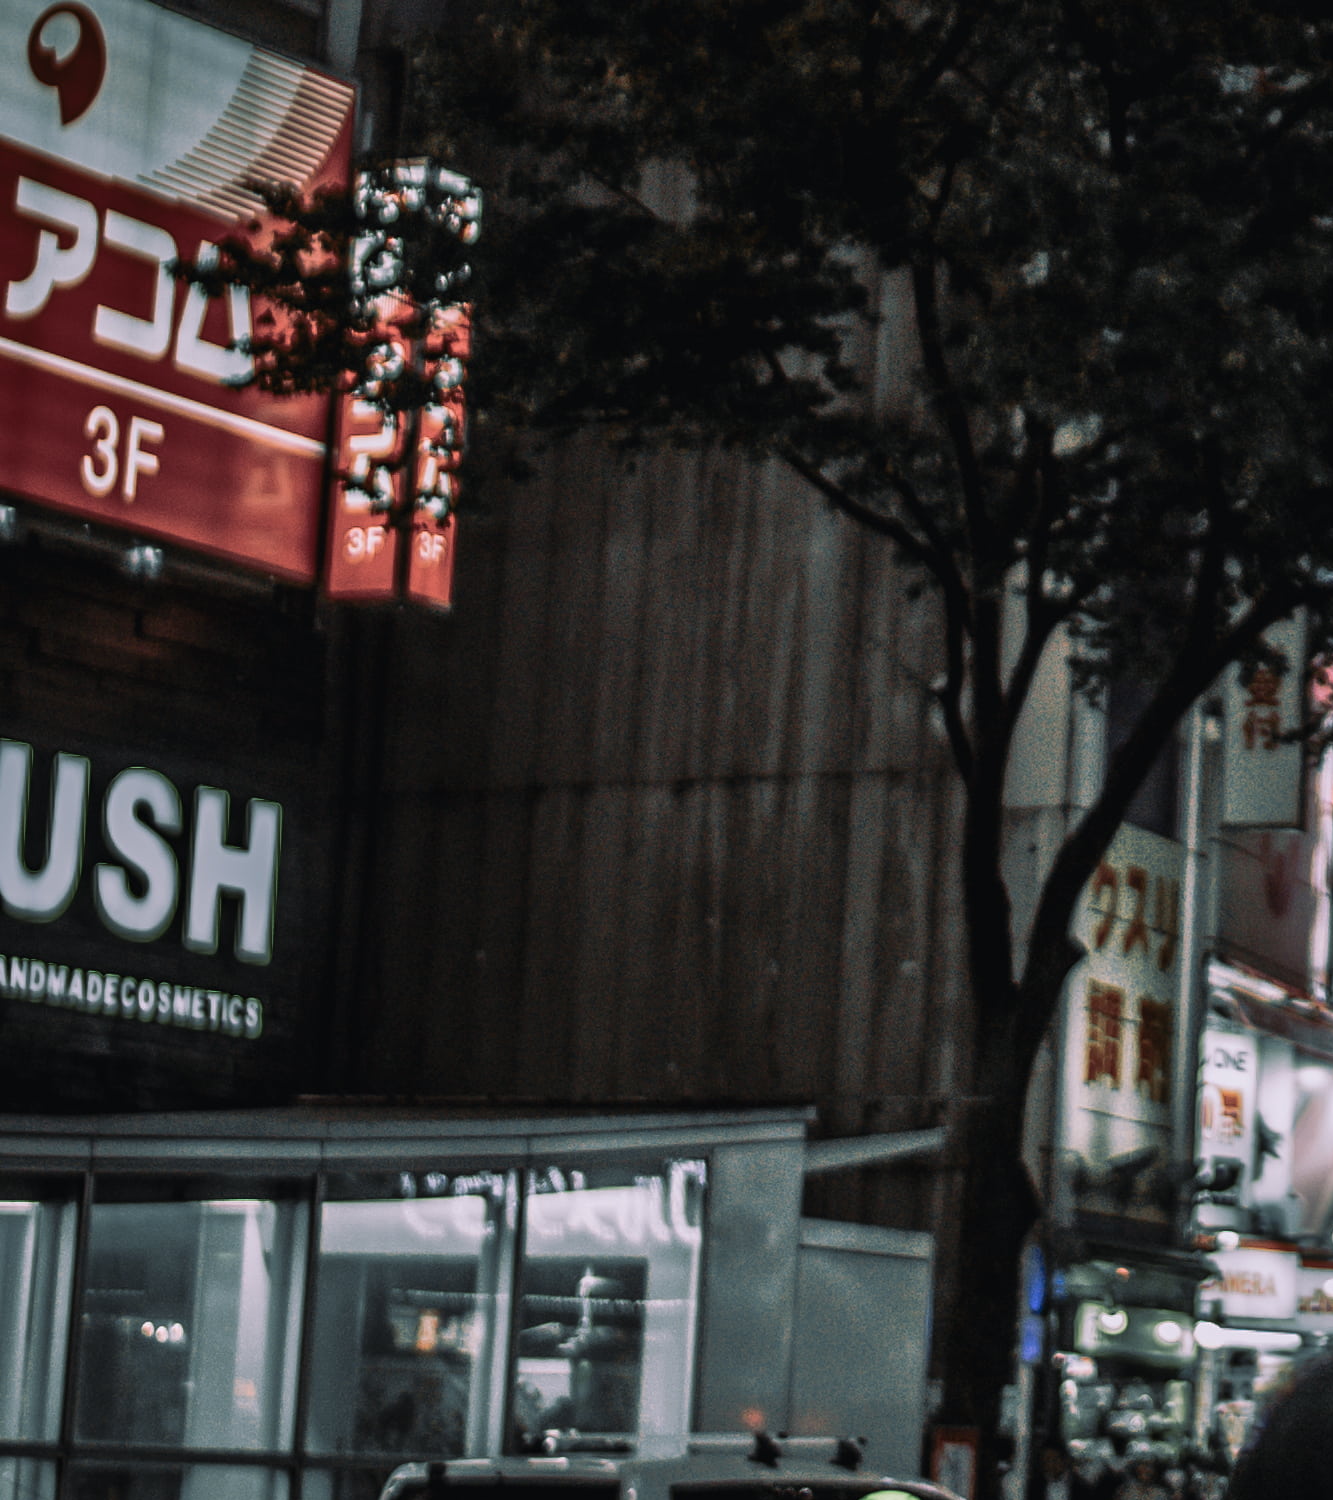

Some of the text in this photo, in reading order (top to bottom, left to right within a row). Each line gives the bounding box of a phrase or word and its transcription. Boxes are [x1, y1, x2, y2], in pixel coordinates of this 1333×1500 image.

[5, 175, 256, 386] アコム
[80, 405, 165, 501] 3F
[346, 526, 386, 557] 3F
[418, 531, 446, 564] 3F
